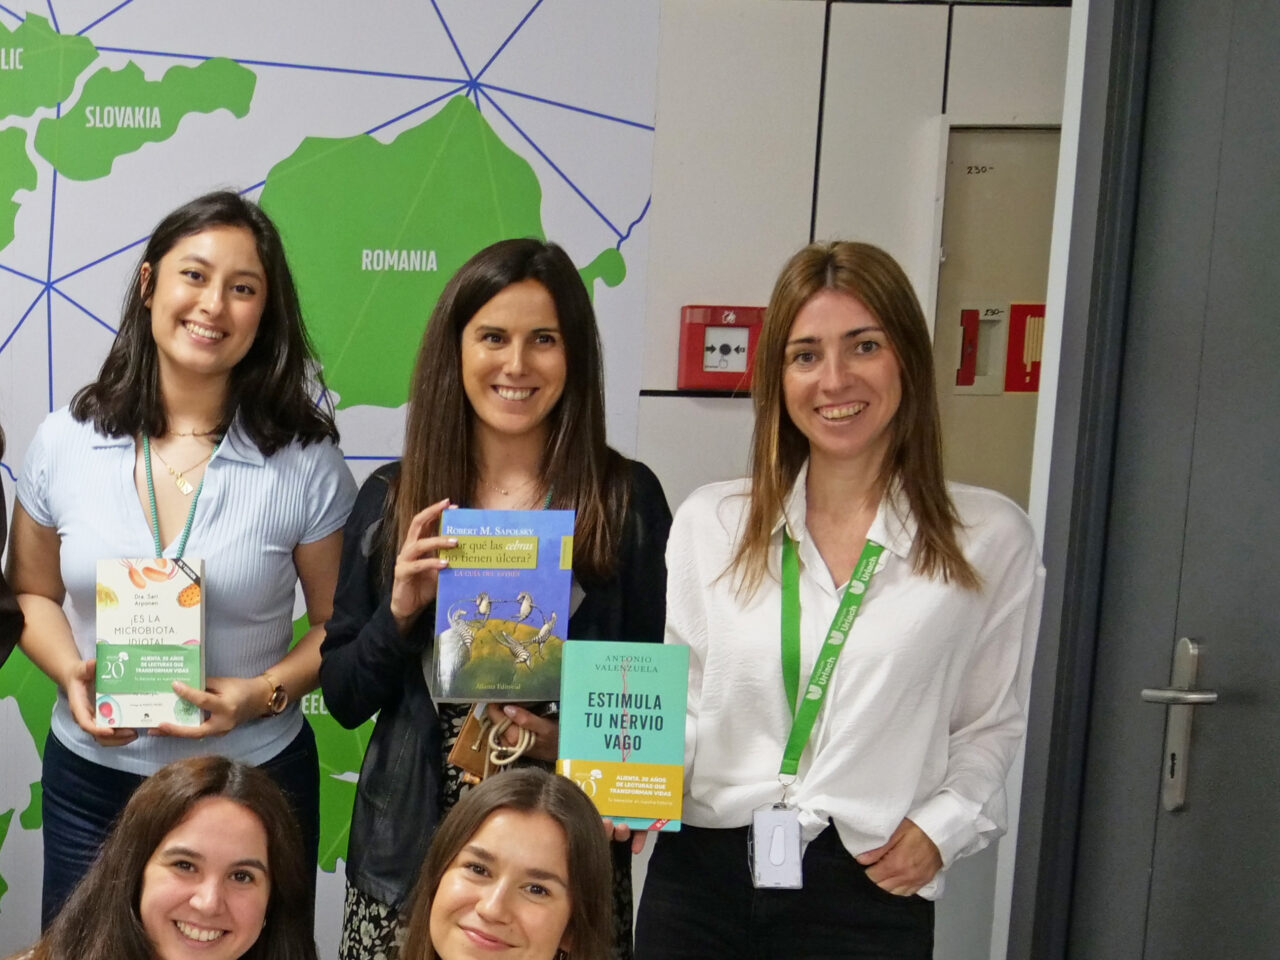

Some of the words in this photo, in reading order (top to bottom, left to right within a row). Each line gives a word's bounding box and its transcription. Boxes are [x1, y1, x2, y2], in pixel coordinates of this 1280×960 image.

[85, 106, 161, 129] SLOVAKIA
[361, 249, 437, 272] ROMANIA
[480, 526, 492, 535] M.
[469, 541, 487, 553] qué
[490, 540, 503, 550] las
[461, 553, 492, 563] tienen
[148, 615, 161, 623] LA
[605, 655, 652, 663] ANTONIO
[595, 664, 659, 674] VALENZUELA
[588, 692, 662, 710] ESTIMULA
[584, 712, 603, 728] TU
[609, 713, 664, 731] NERVIO
[604, 733, 642, 751] VAGO
